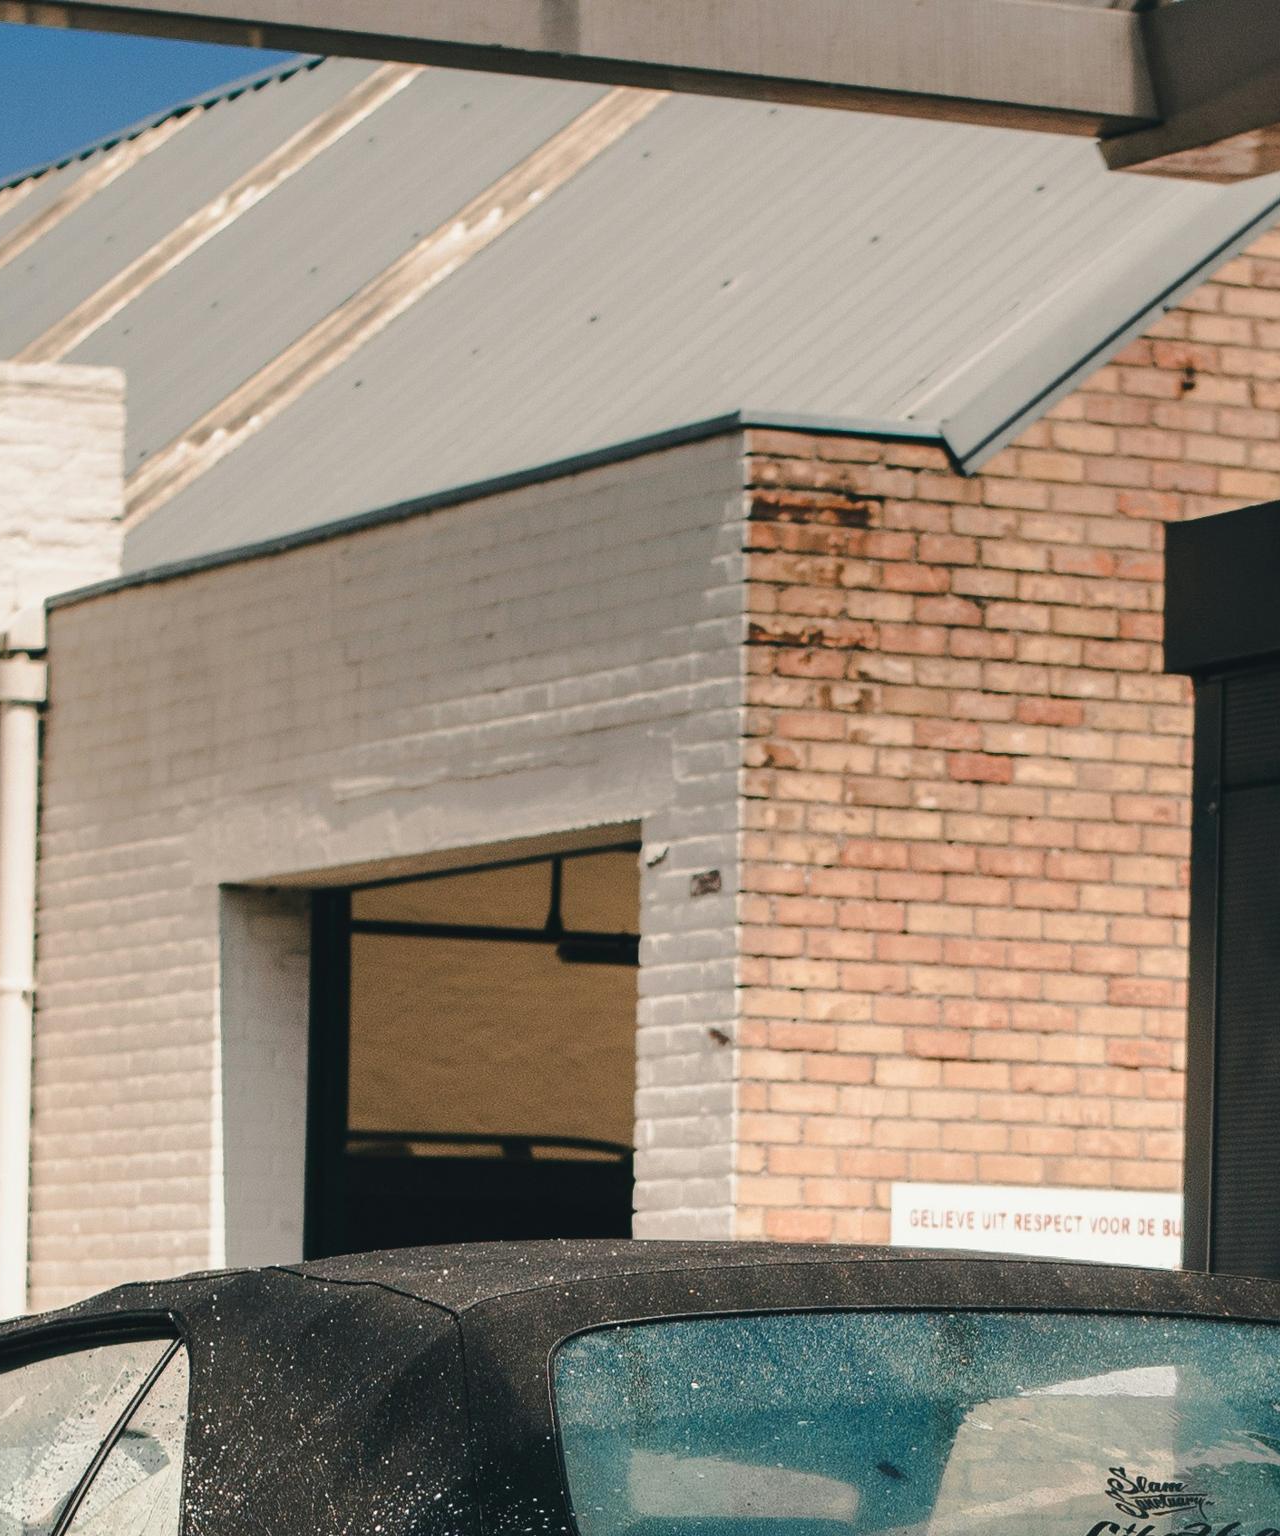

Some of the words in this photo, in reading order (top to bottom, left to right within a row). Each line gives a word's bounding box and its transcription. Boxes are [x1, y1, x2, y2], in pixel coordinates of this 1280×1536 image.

[910, 1208, 975, 1231] GELIEVE
[982, 1211, 1007, 1231] UIT
[1014, 1212, 1082, 1234] RESPECT
[1089, 1215, 1131, 1235] VOOR
[1138, 1217, 1155, 1236] DE
[1107, 1466, 1188, 1495] Slam
